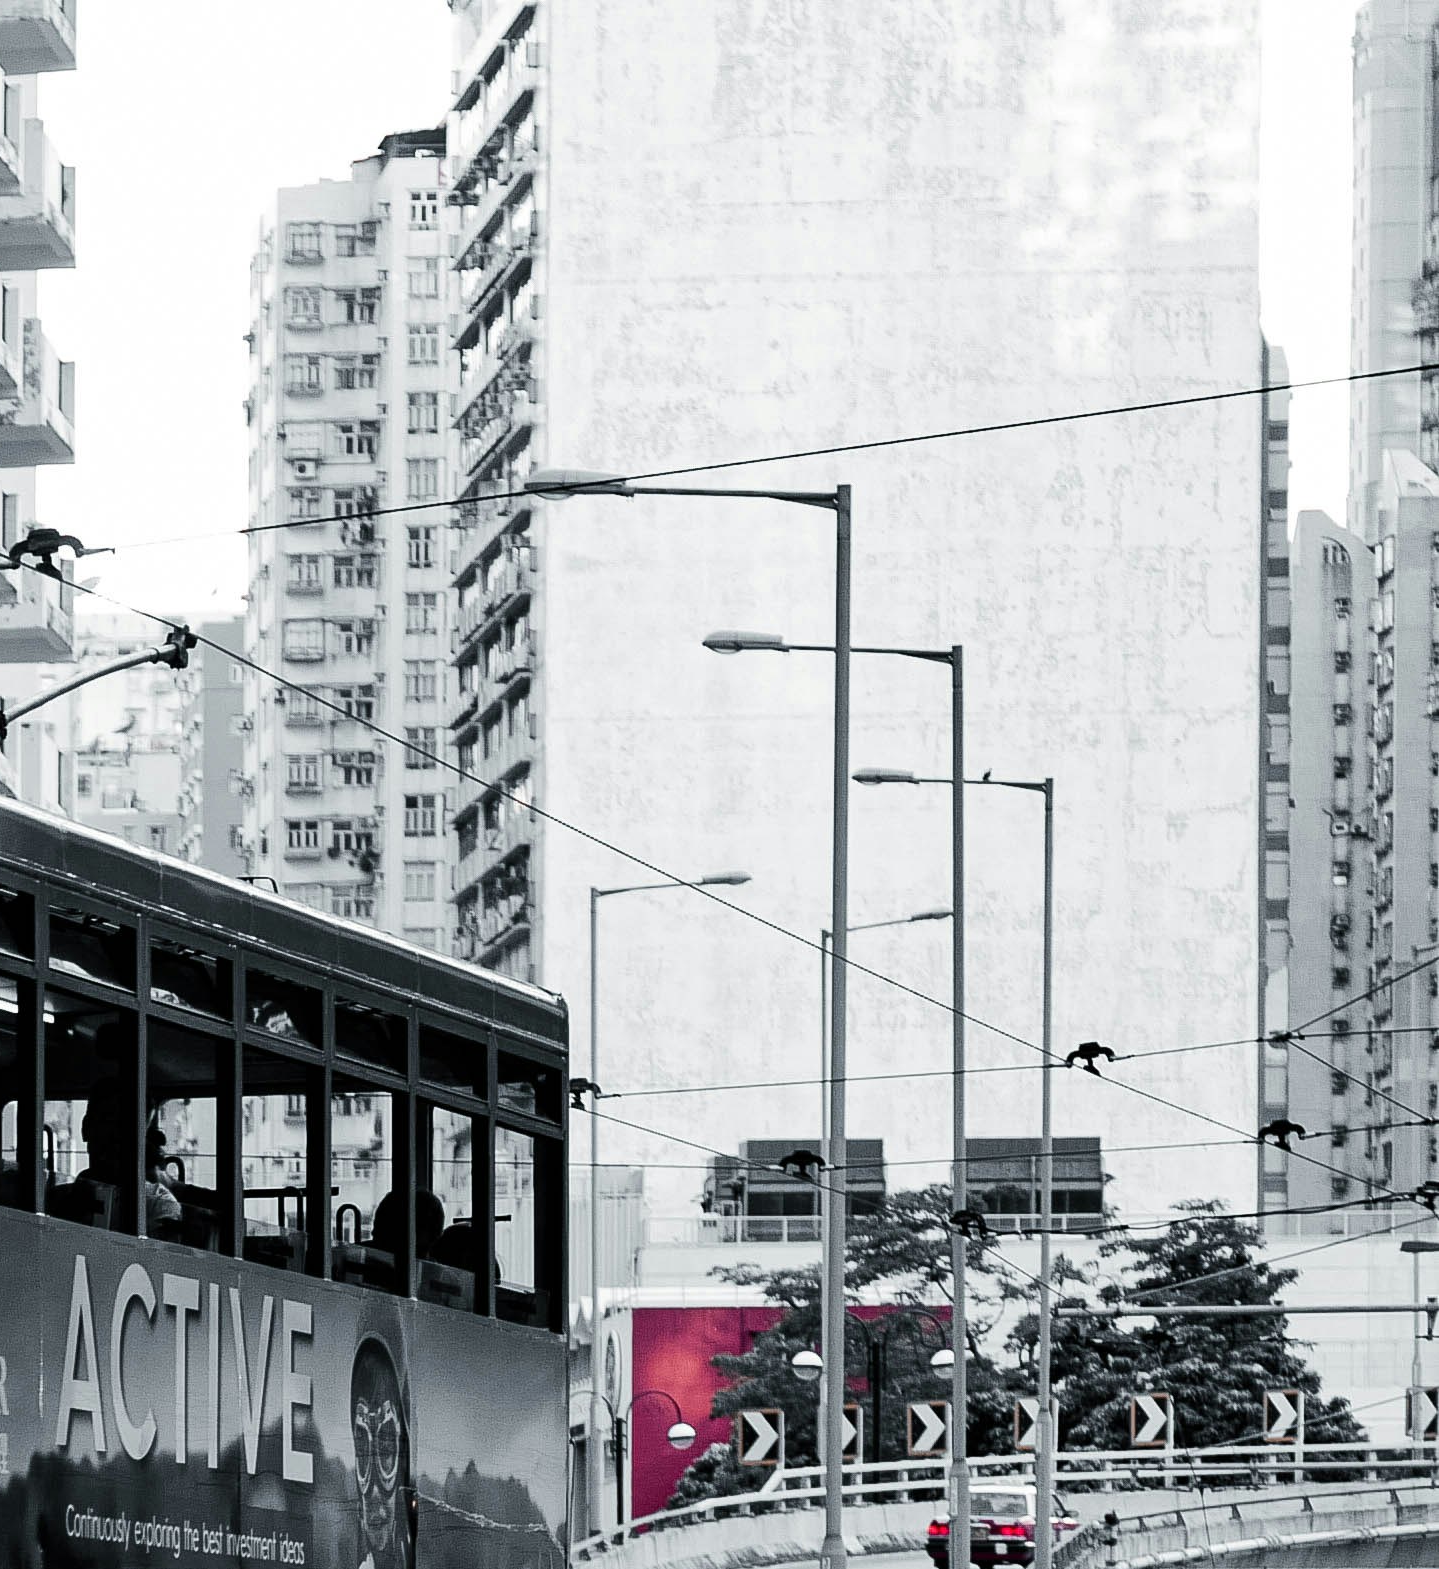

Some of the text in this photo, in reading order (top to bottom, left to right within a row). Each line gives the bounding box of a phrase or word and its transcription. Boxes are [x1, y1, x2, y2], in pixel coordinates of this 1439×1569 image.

[56, 1253, 314, 1483] ACTIVE
[66, 1504, 305, 1565] Continuously exploring the best investment ideas
